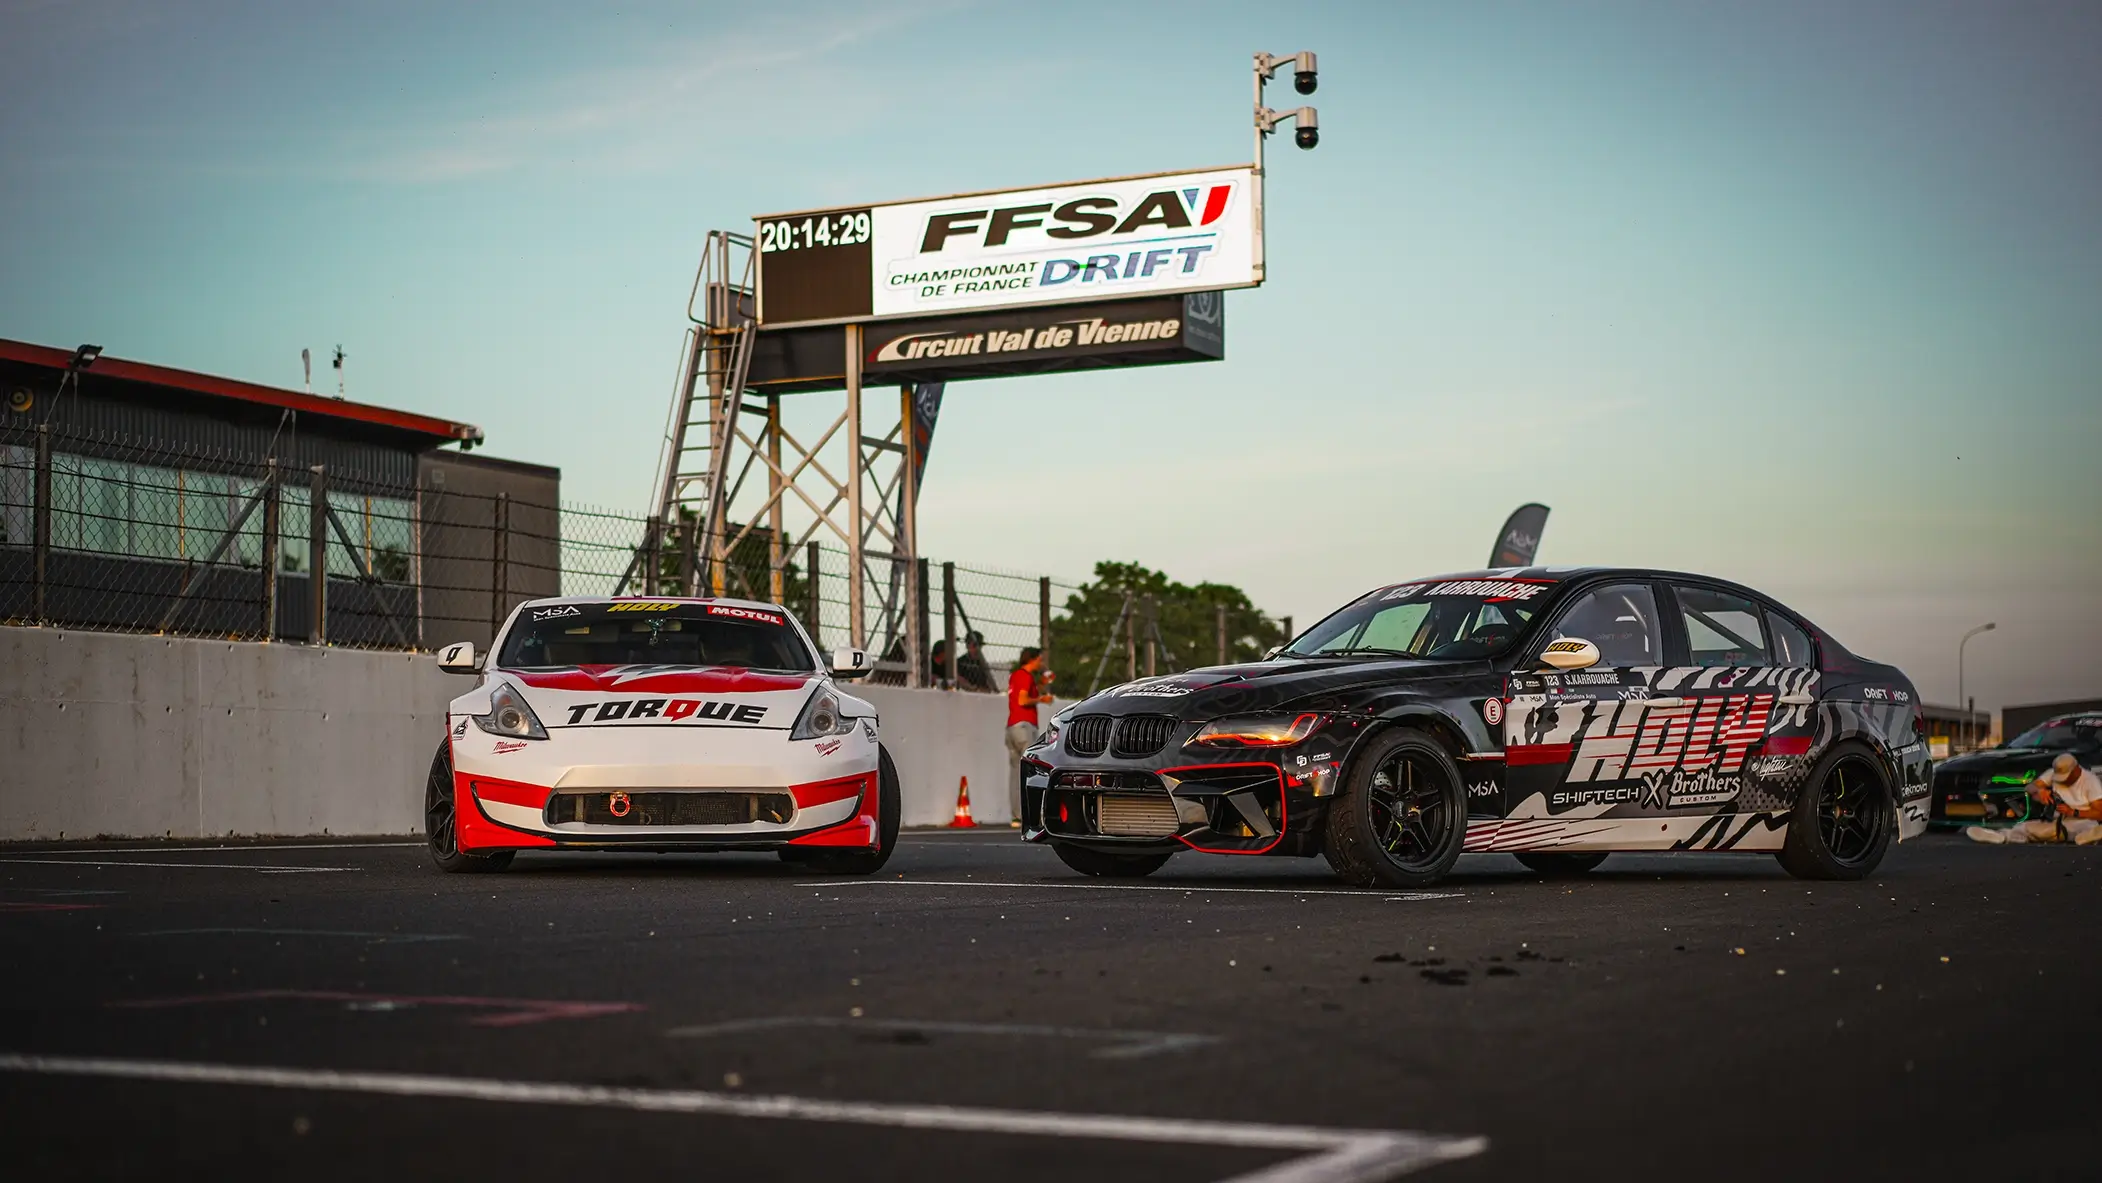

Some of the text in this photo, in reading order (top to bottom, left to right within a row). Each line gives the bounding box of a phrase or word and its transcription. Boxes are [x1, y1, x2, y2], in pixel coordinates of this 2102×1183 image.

[761, 212, 871, 253] 20:14:29
[920, 190, 1192, 254] FFSA
[890, 244, 1213, 287] CHAMPIONNAT DRIFT
[921, 276, 1033, 298] DE FRANCE
[877, 331, 985, 363] Circuit
[986, 328, 1035, 354] Val
[1034, 326, 1074, 350] de
[1076, 318, 1180, 346] Vienne
[1380, 583, 1427, 602] 123
[1424, 581, 1549, 601] KARROUACHE
[533, 605, 580, 619] MSA
[607, 602, 681, 613] HOLY
[711, 606, 780, 625] MOTUL
[1548, 642, 1587, 653] HOLY
[1545, 673, 1620, 687] 123 S.KARROUACHE
[567, 698, 769, 725] TORQUE
[1566, 694, 1774, 783] HOLY
[1468, 779, 1499, 798] MSA
[1552, 769, 1741, 809] SHIFTECH X Brothers
[1679, 794, 1717, 803] CUSTOM
